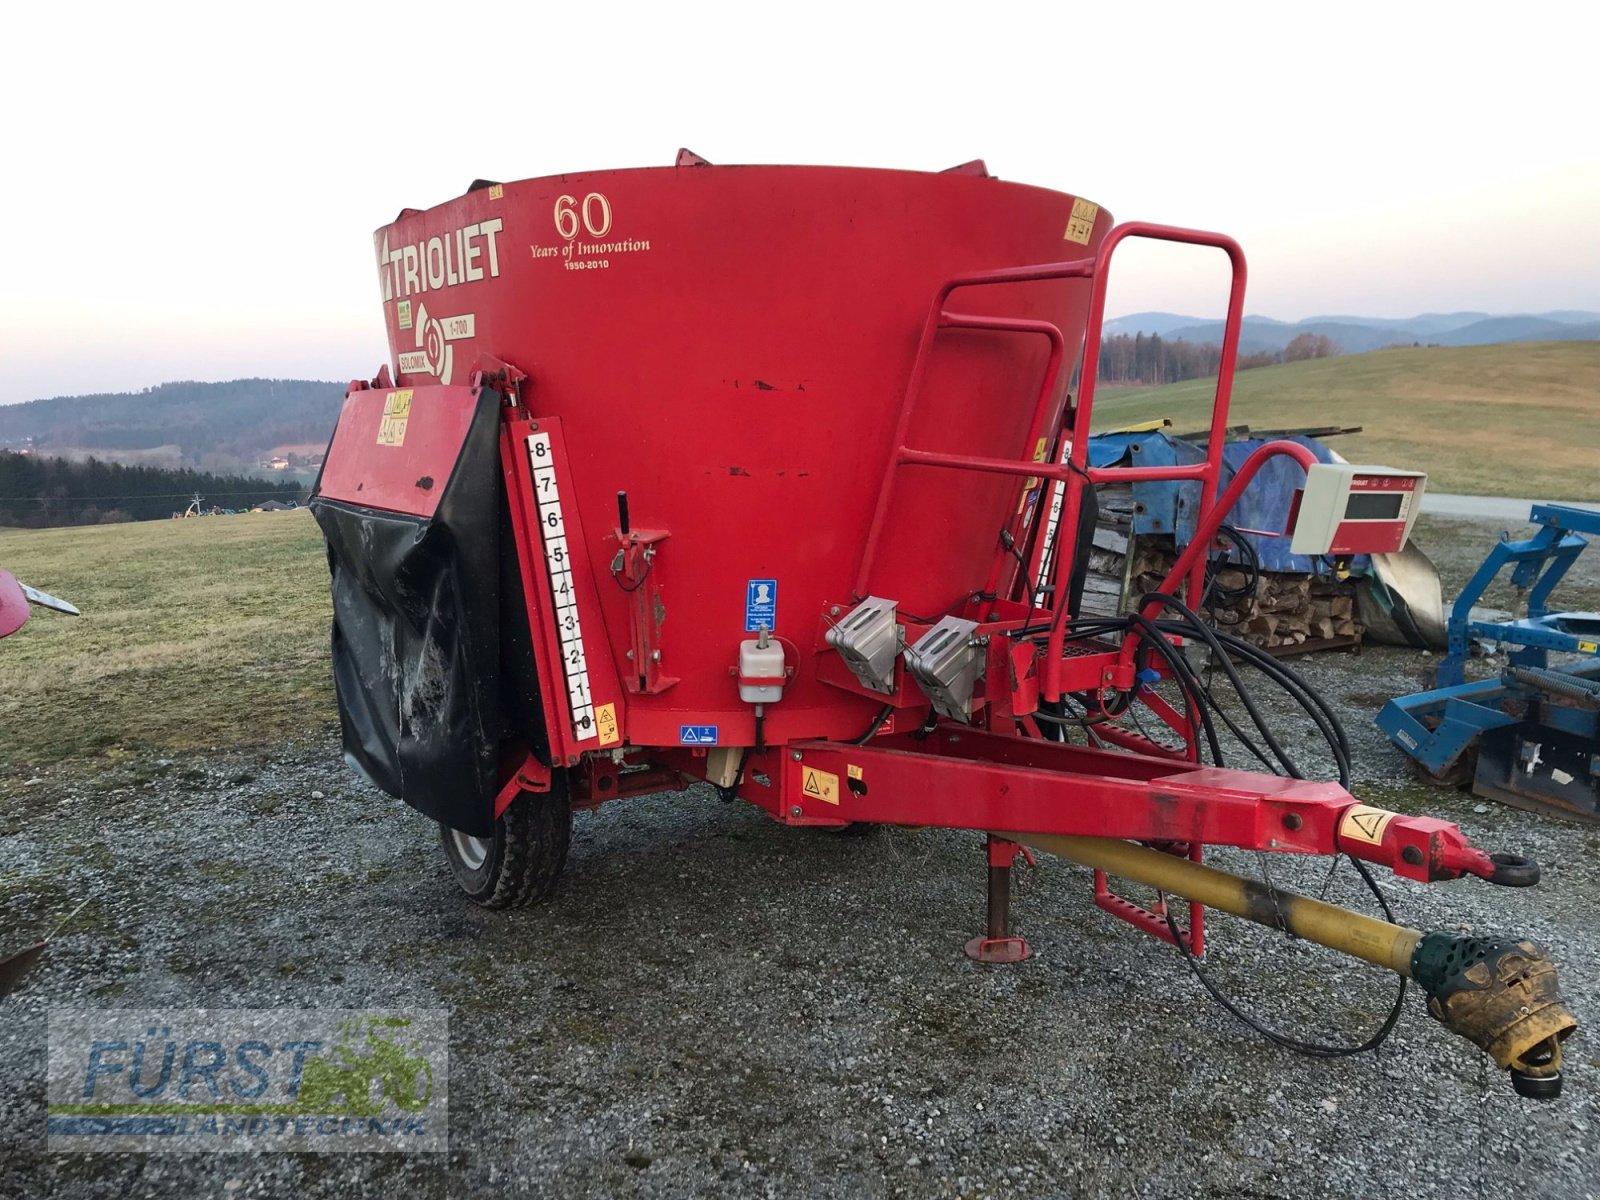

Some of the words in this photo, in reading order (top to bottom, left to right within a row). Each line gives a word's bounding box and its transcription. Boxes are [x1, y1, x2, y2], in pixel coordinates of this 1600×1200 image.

[554, 192, 612, 240] 60
[389, 217, 503, 298] TRIOLIET
[530, 244, 558, 258] Years
[562, 240, 575, 263] of
[578, 238, 650, 255] Innovation
[564, 260, 609, 271] 1950-2010
[535, 442, 546, 457] 8
[540, 477, 550, 492] 7
[547, 512, 558, 527] 6
[554, 547, 564, 562] 5
[559, 581, 570, 595] 4
[565, 616, 575, 631] 3
[570, 649, 581, 664] 2
[576, 683, 584, 697] 1
